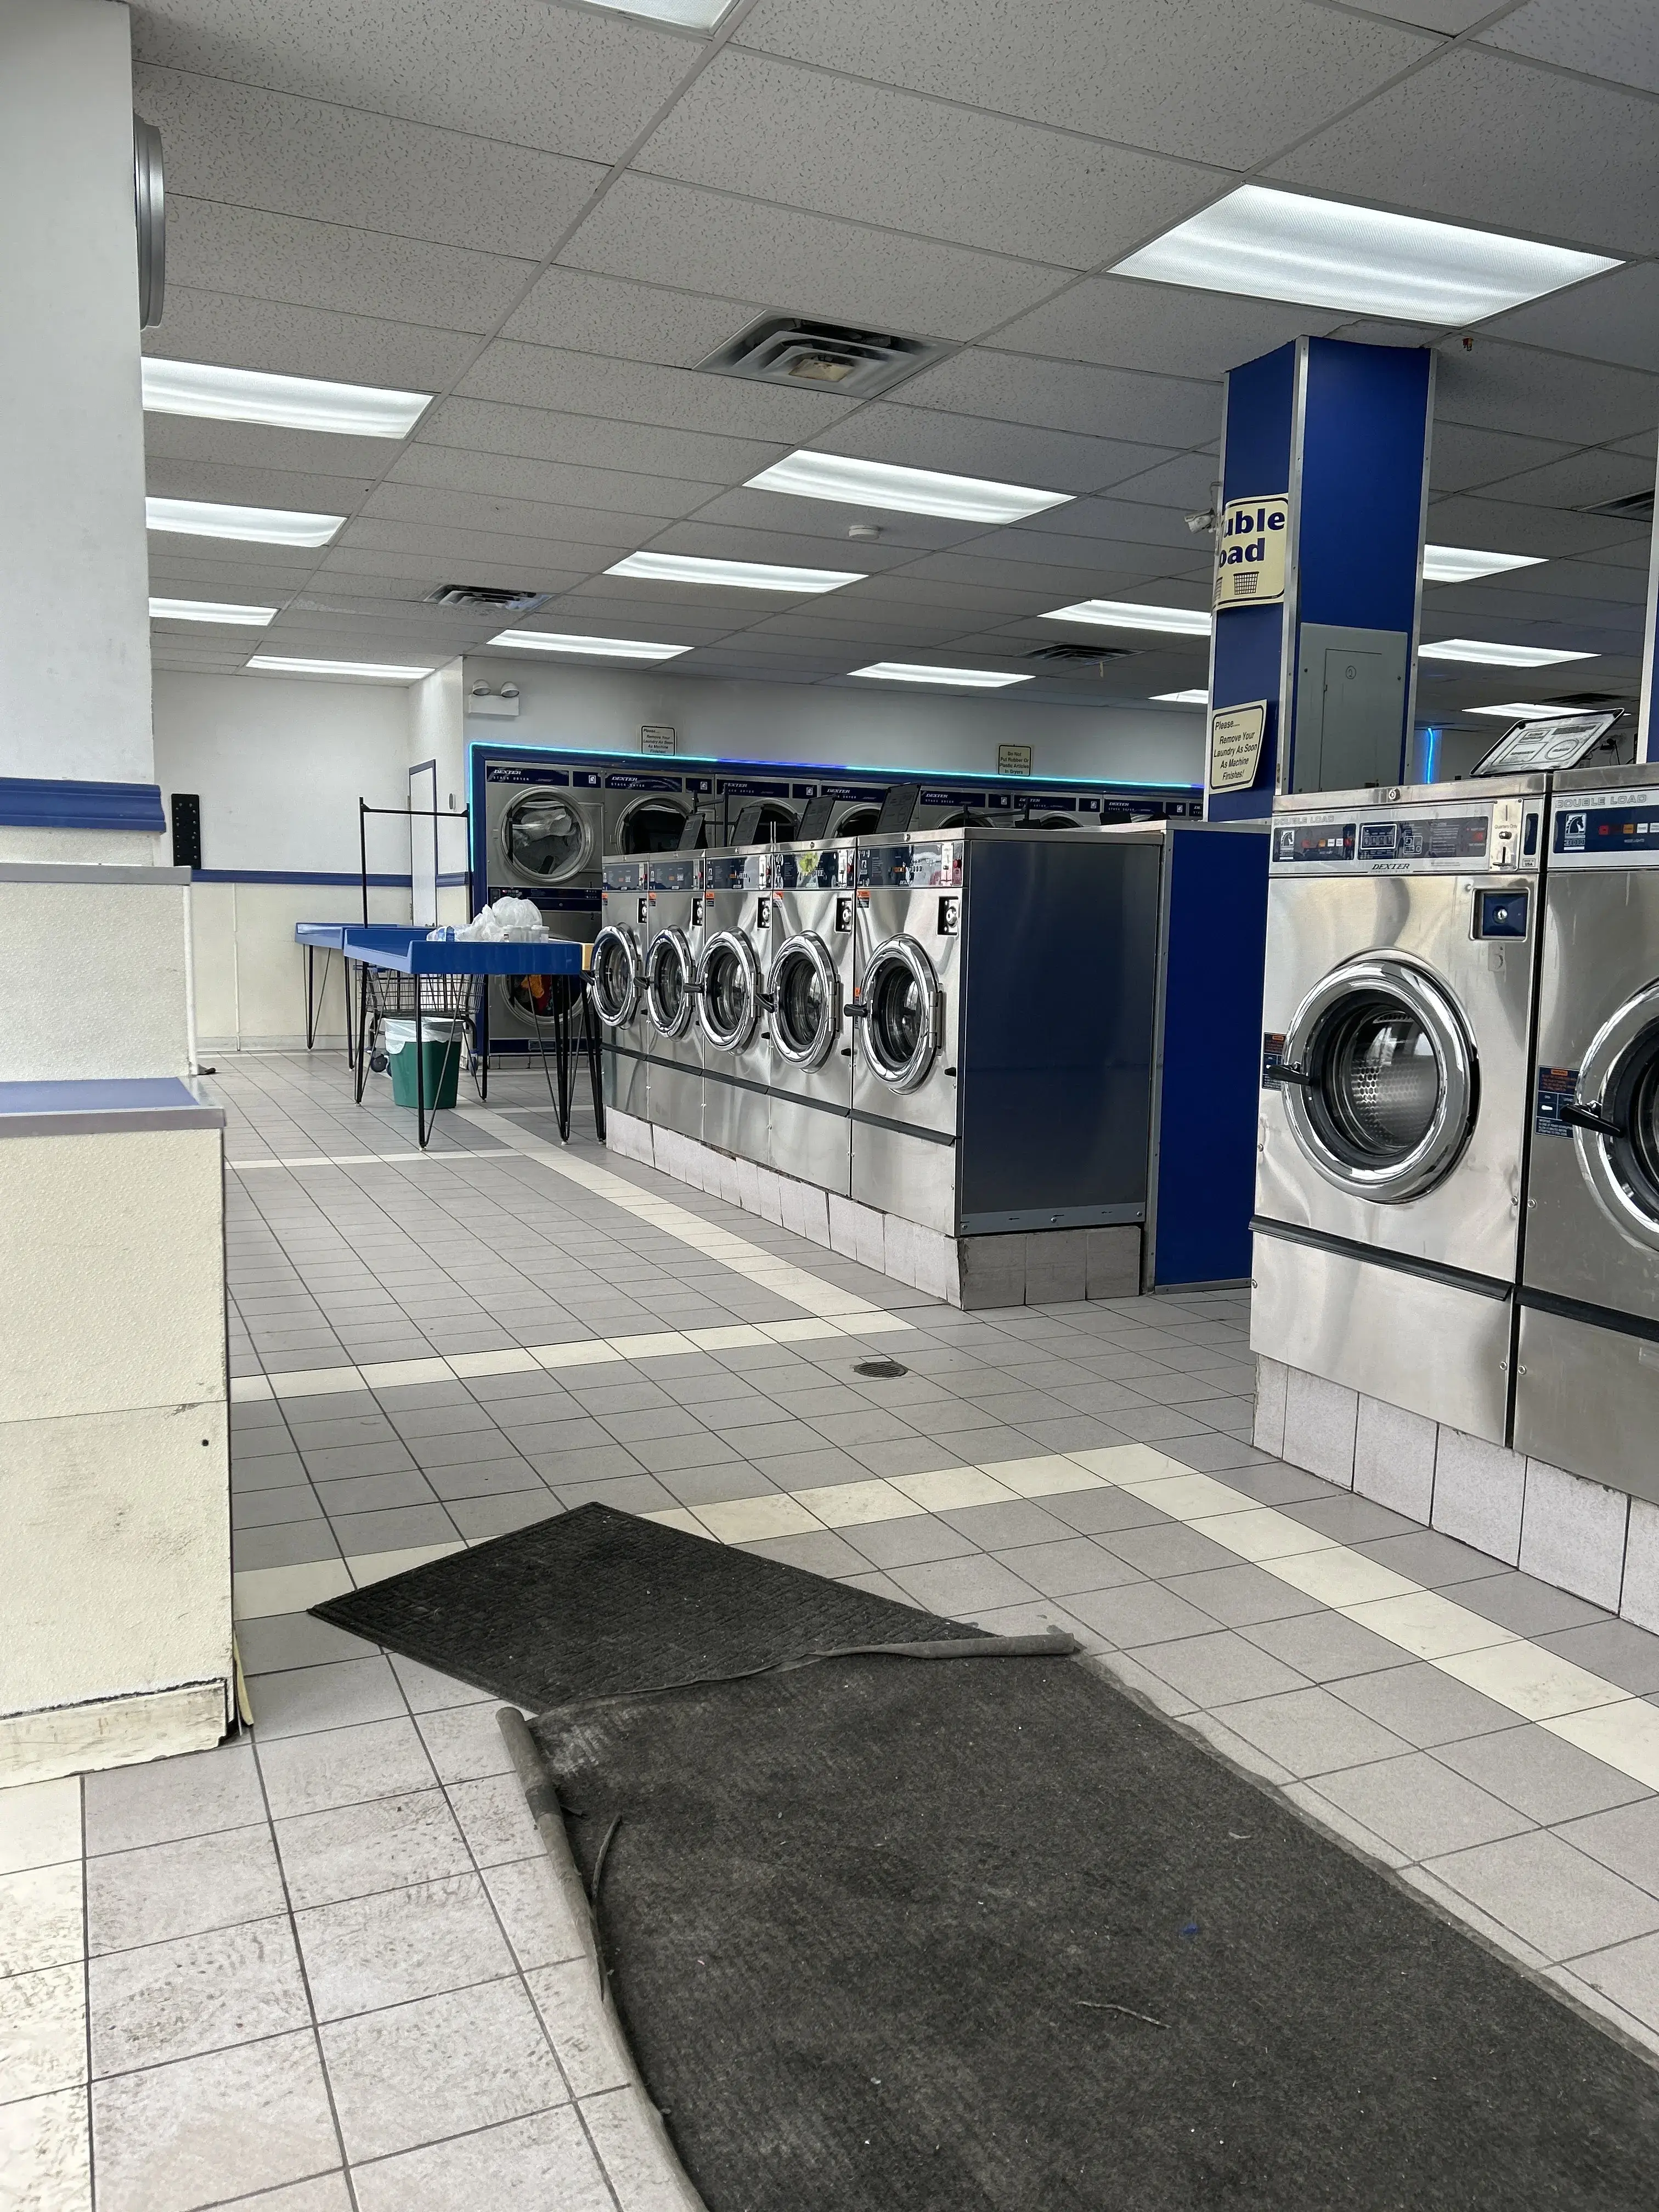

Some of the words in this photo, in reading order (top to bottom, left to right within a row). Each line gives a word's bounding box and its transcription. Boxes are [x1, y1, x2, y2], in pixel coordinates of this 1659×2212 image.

[1219, 734, 1241, 744] Remove
[1243, 731, 1255, 740] Your
[1214, 747, 1235, 757] Laundry
[1236, 745, 1243, 754] As
[1244, 743, 1257, 752] Soon
[1220, 760, 1227, 769] As
[1228, 757, 1249, 768] Machine
[1222, 769, 1245, 781] Finishes!
[1555, 797, 1606, 808] DOUBLE
[1610, 794, 1647, 804] LOAD
[1274, 816, 1307, 825] DOUBLE
